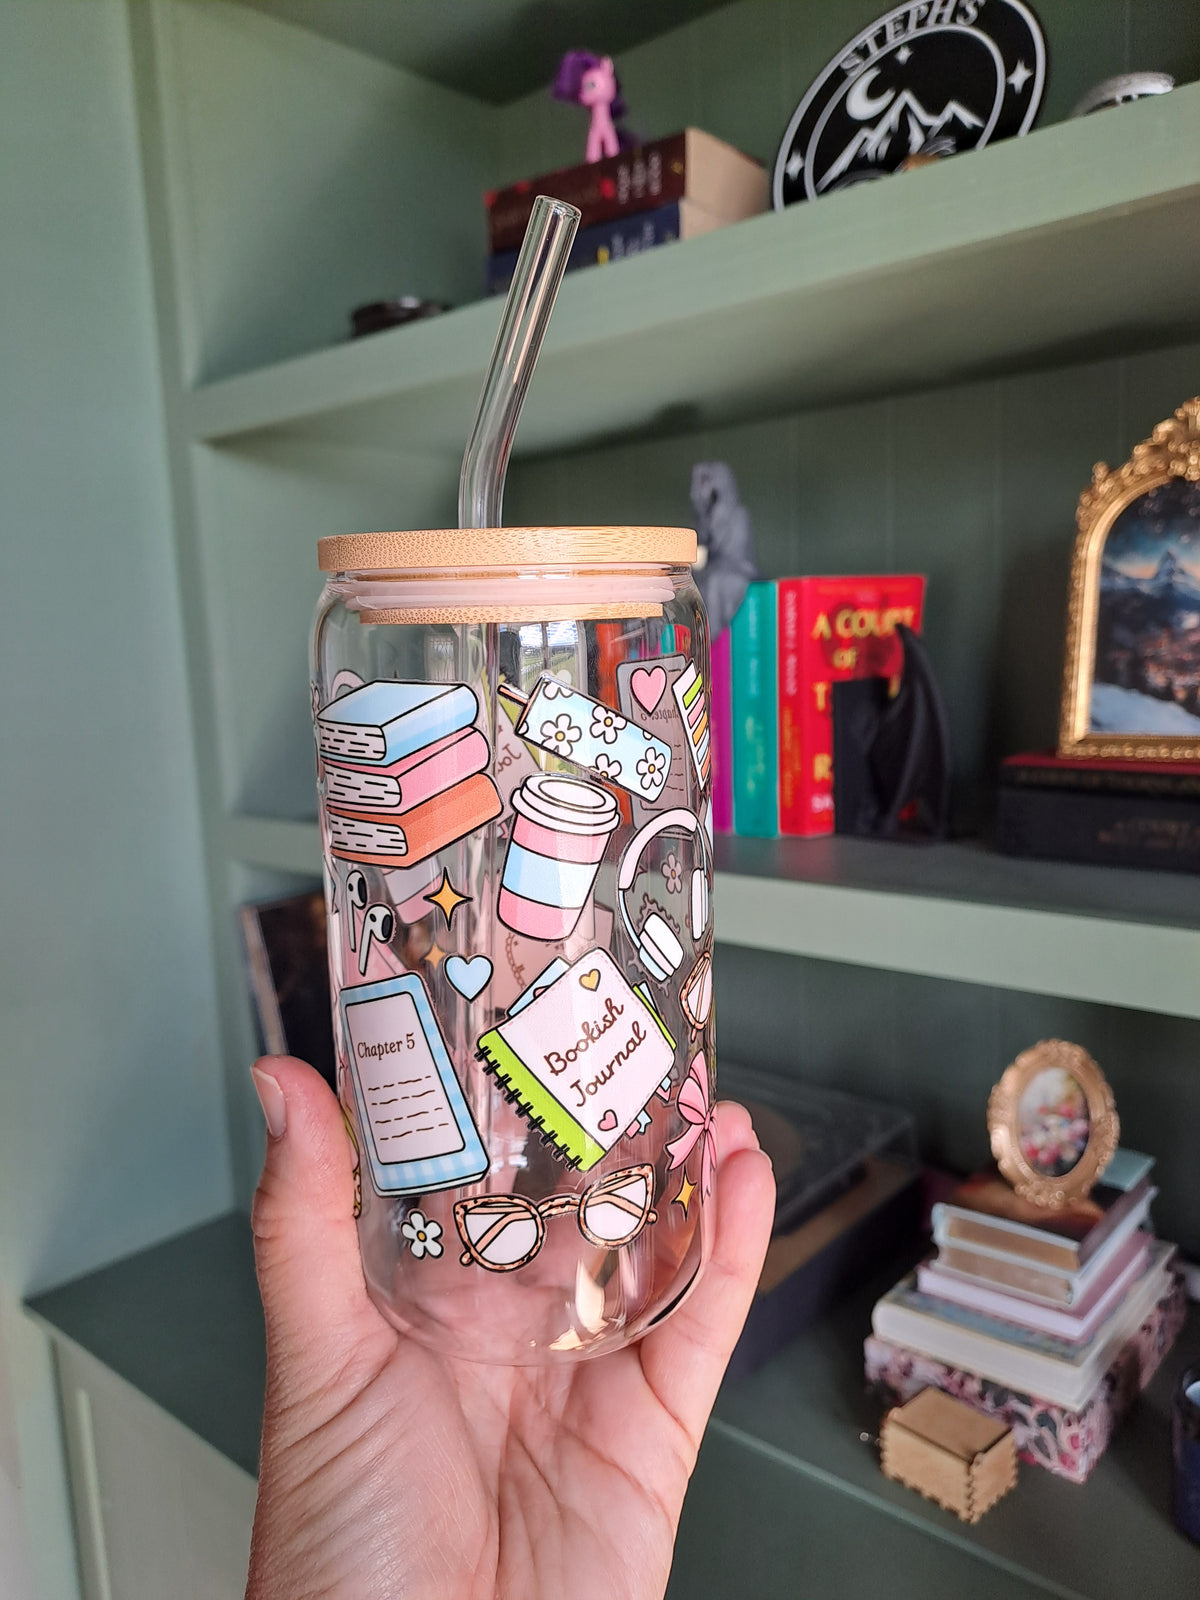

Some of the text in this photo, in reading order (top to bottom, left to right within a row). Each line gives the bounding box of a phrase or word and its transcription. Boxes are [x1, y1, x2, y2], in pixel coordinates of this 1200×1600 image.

[357, 1032, 415, 1061] Chapter 5
[543, 997, 624, 1077] Bookish
[569, 1020, 647, 1108] Journal
